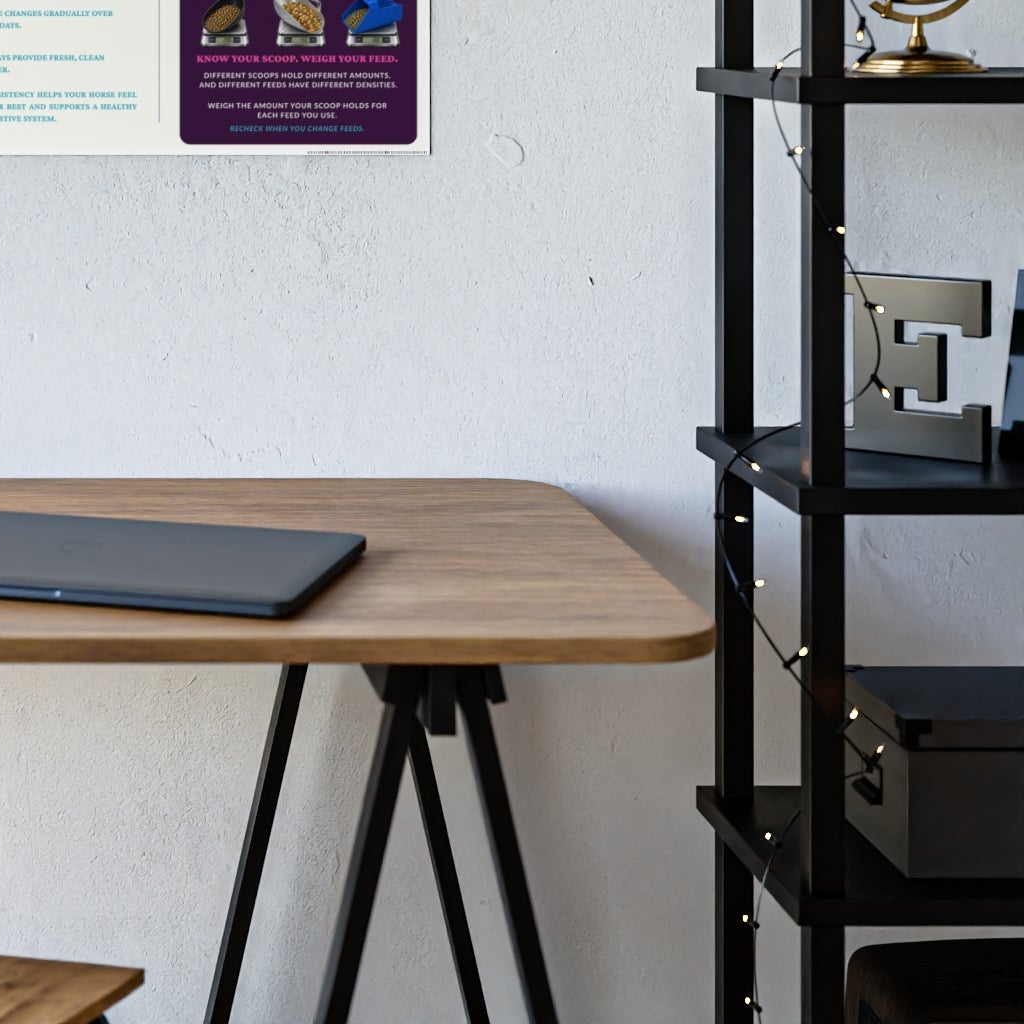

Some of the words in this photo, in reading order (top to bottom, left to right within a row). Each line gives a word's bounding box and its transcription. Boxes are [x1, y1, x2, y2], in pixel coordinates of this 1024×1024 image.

[49, 54, 77, 62] FRESH,
[197, 55, 229, 63] KNOW
[232, 55, 260, 63] YOUR
[262, 55, 298, 63] SCOOP.
[301, 55, 336, 63] WEIGH
[338, 55, 367, 63] YOUR
[369, 55, 398, 63] FEED.
